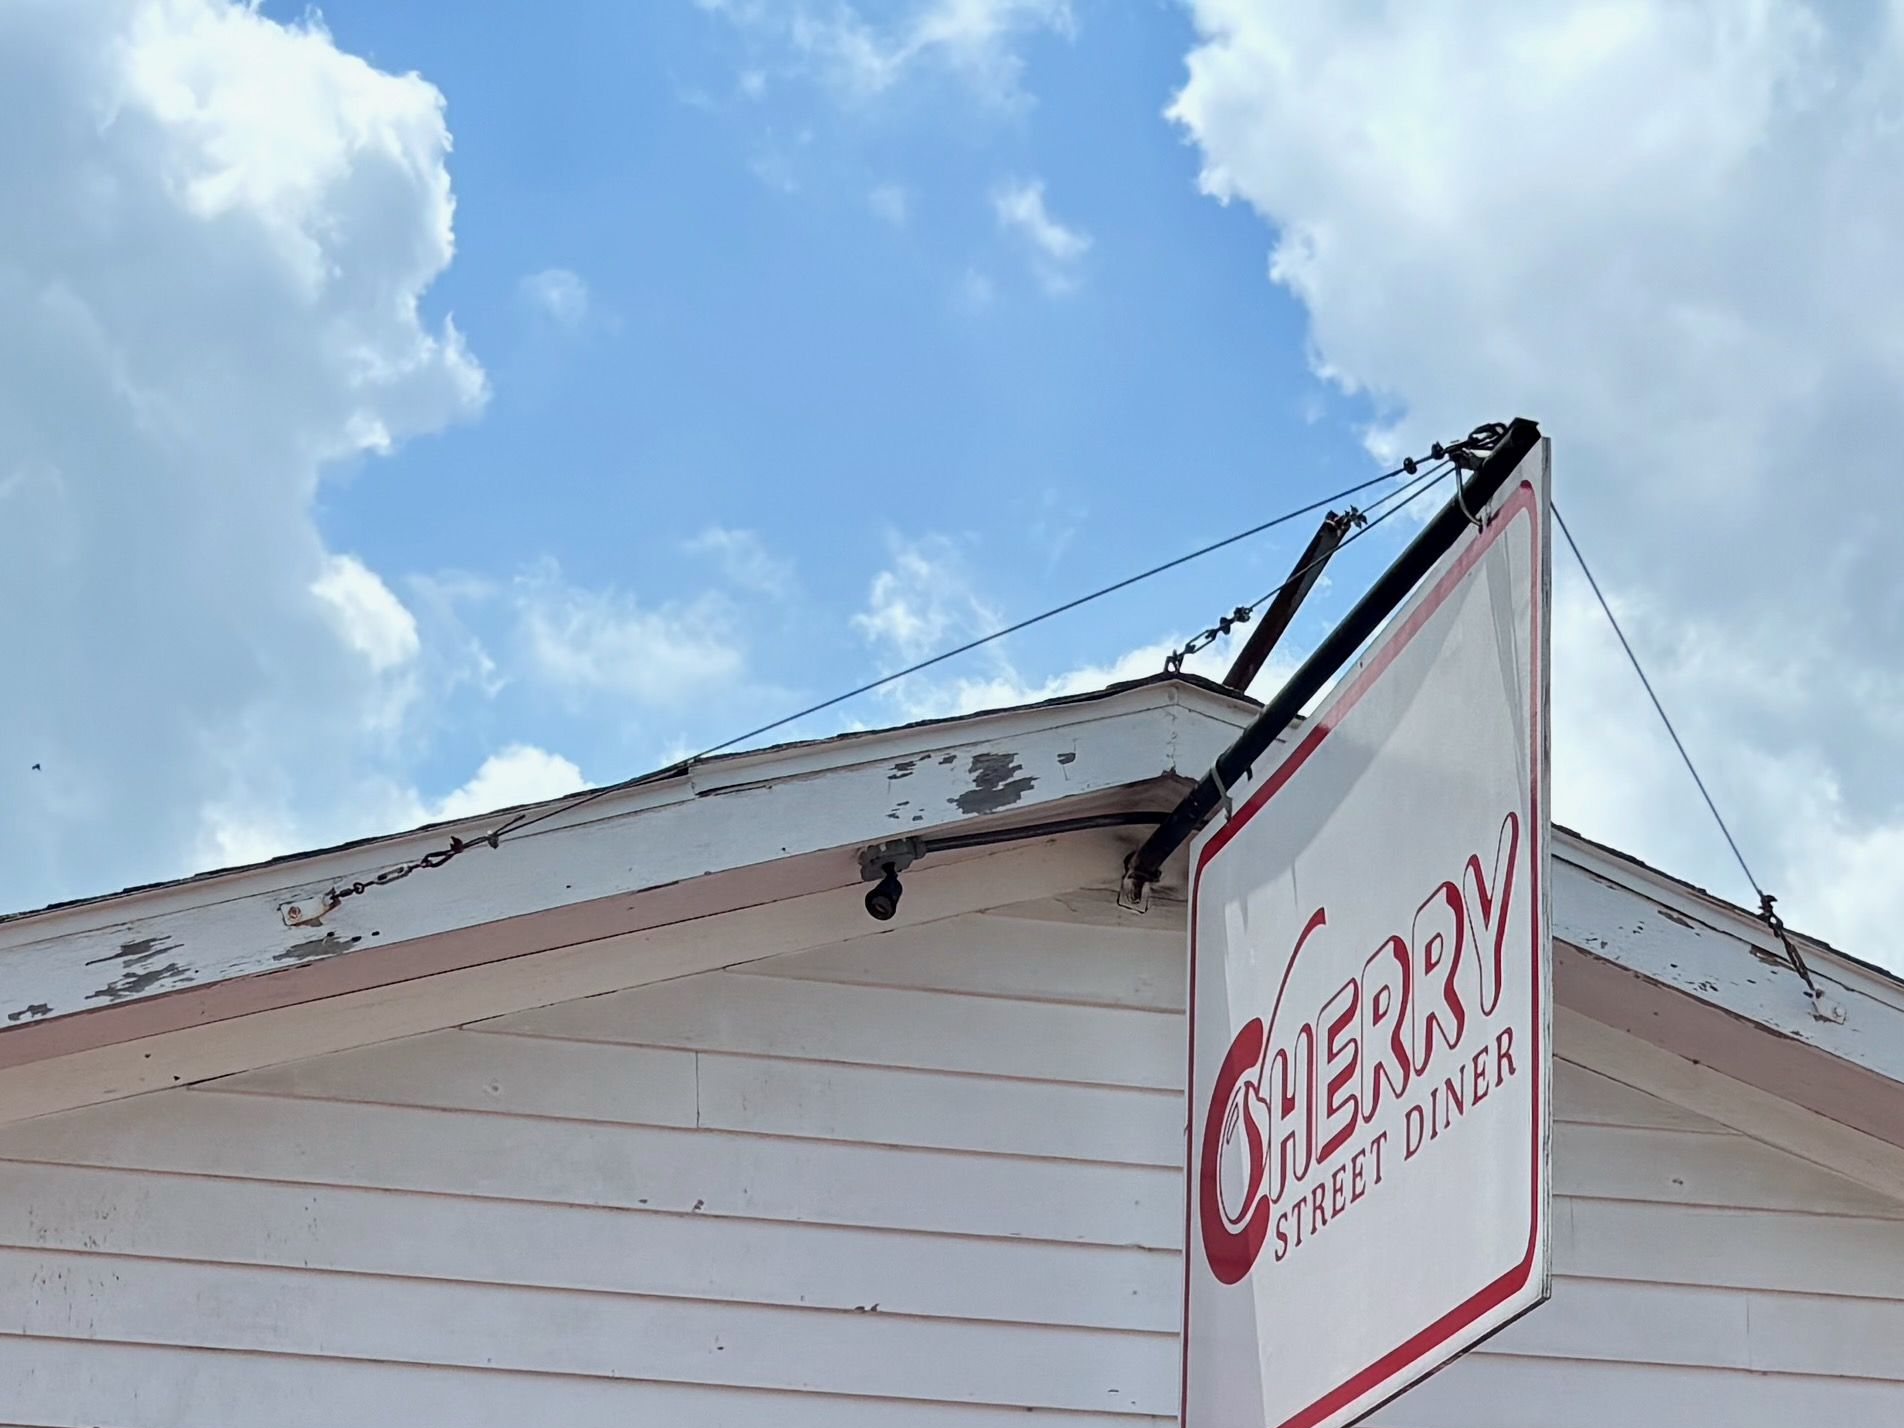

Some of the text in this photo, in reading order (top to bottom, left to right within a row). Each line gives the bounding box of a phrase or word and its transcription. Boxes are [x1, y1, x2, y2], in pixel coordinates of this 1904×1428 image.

[1199, 811, 1520, 1286] CHERRY
[1274, 1026, 1517, 1263] STREET DINER
